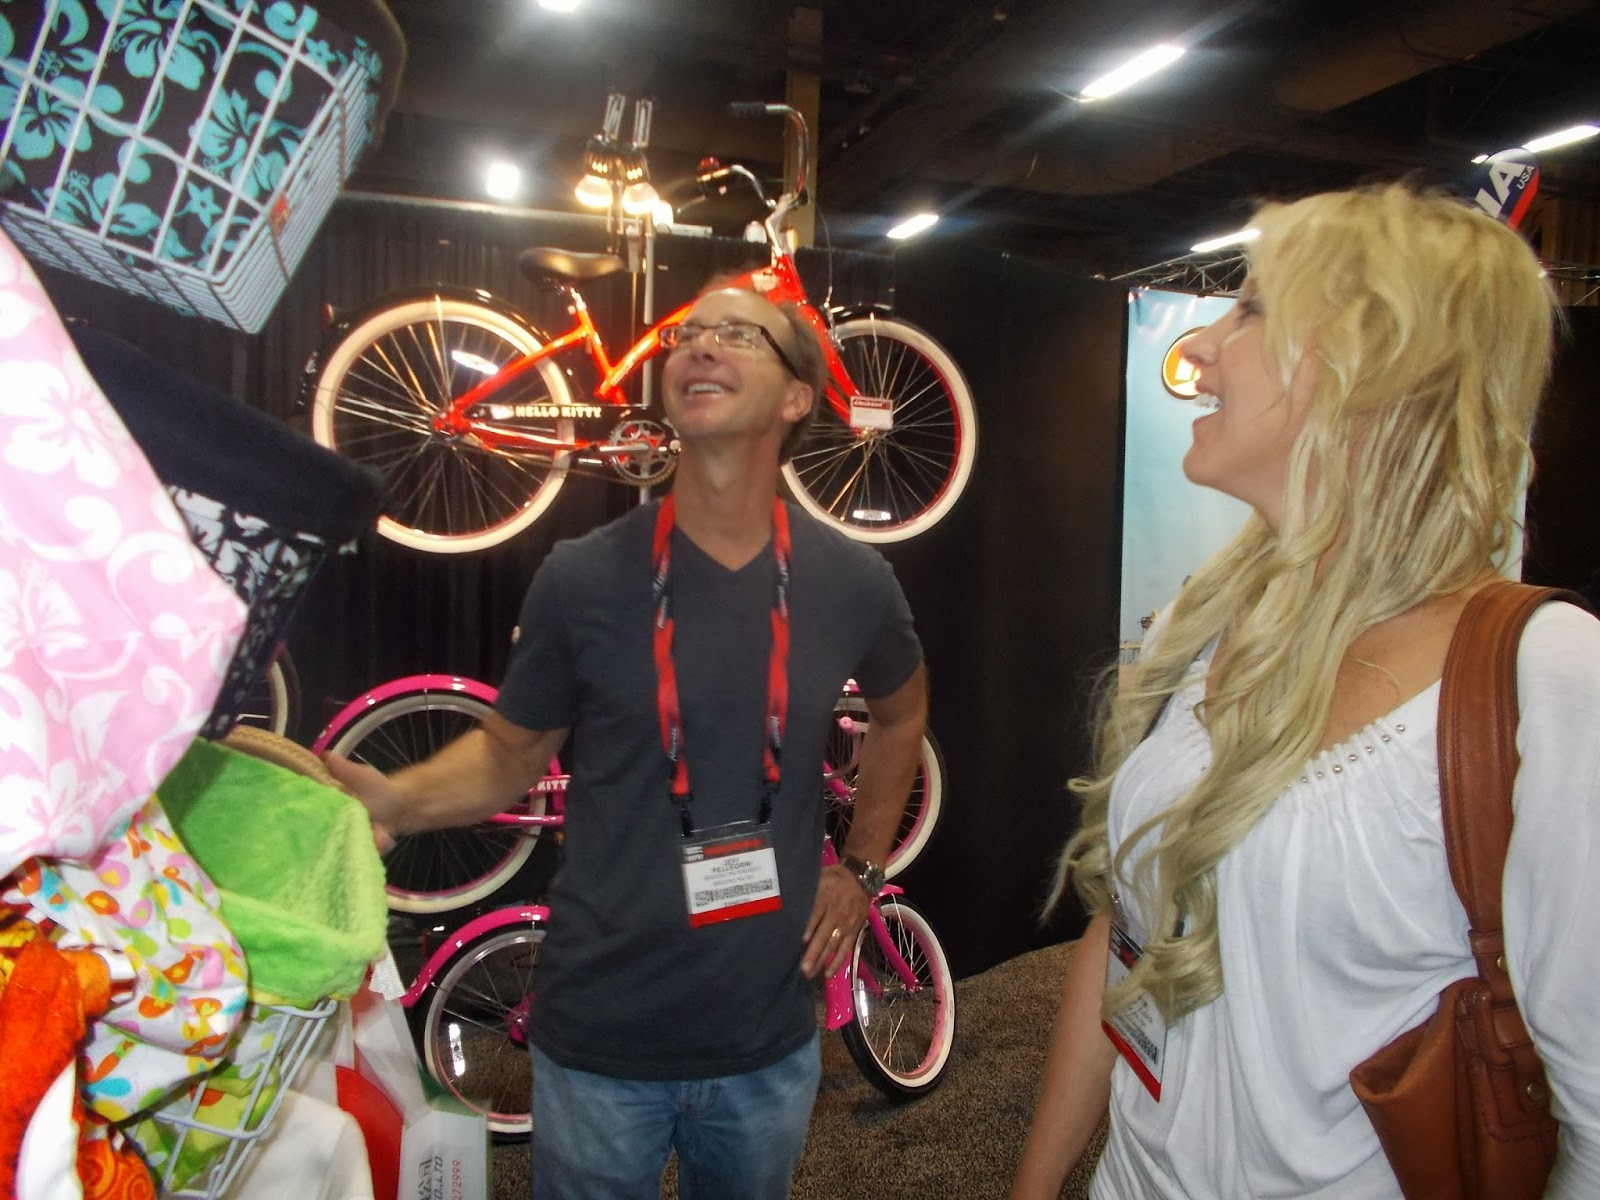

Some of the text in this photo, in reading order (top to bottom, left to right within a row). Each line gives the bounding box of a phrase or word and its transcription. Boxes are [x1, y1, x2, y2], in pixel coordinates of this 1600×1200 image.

[1516, 165, 1535, 190] USA
[515, 405, 602, 418] HELLO KITTY
[537, 779, 571, 791] KITT
